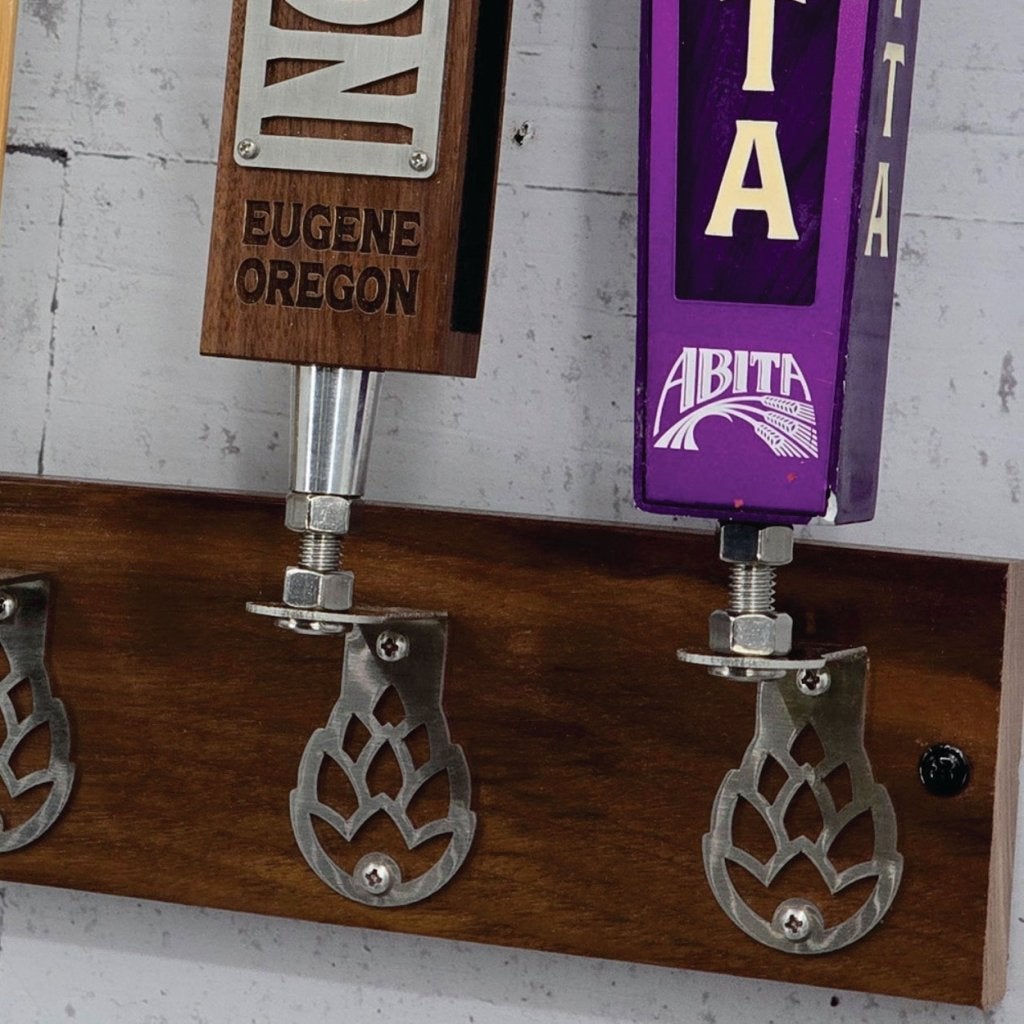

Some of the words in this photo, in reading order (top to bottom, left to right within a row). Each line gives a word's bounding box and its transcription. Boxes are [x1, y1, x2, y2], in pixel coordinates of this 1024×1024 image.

[242, 199, 422, 257] EUGENE
[235, 258, 420, 316] OREGON
[653, 347, 811, 436] ABITA
